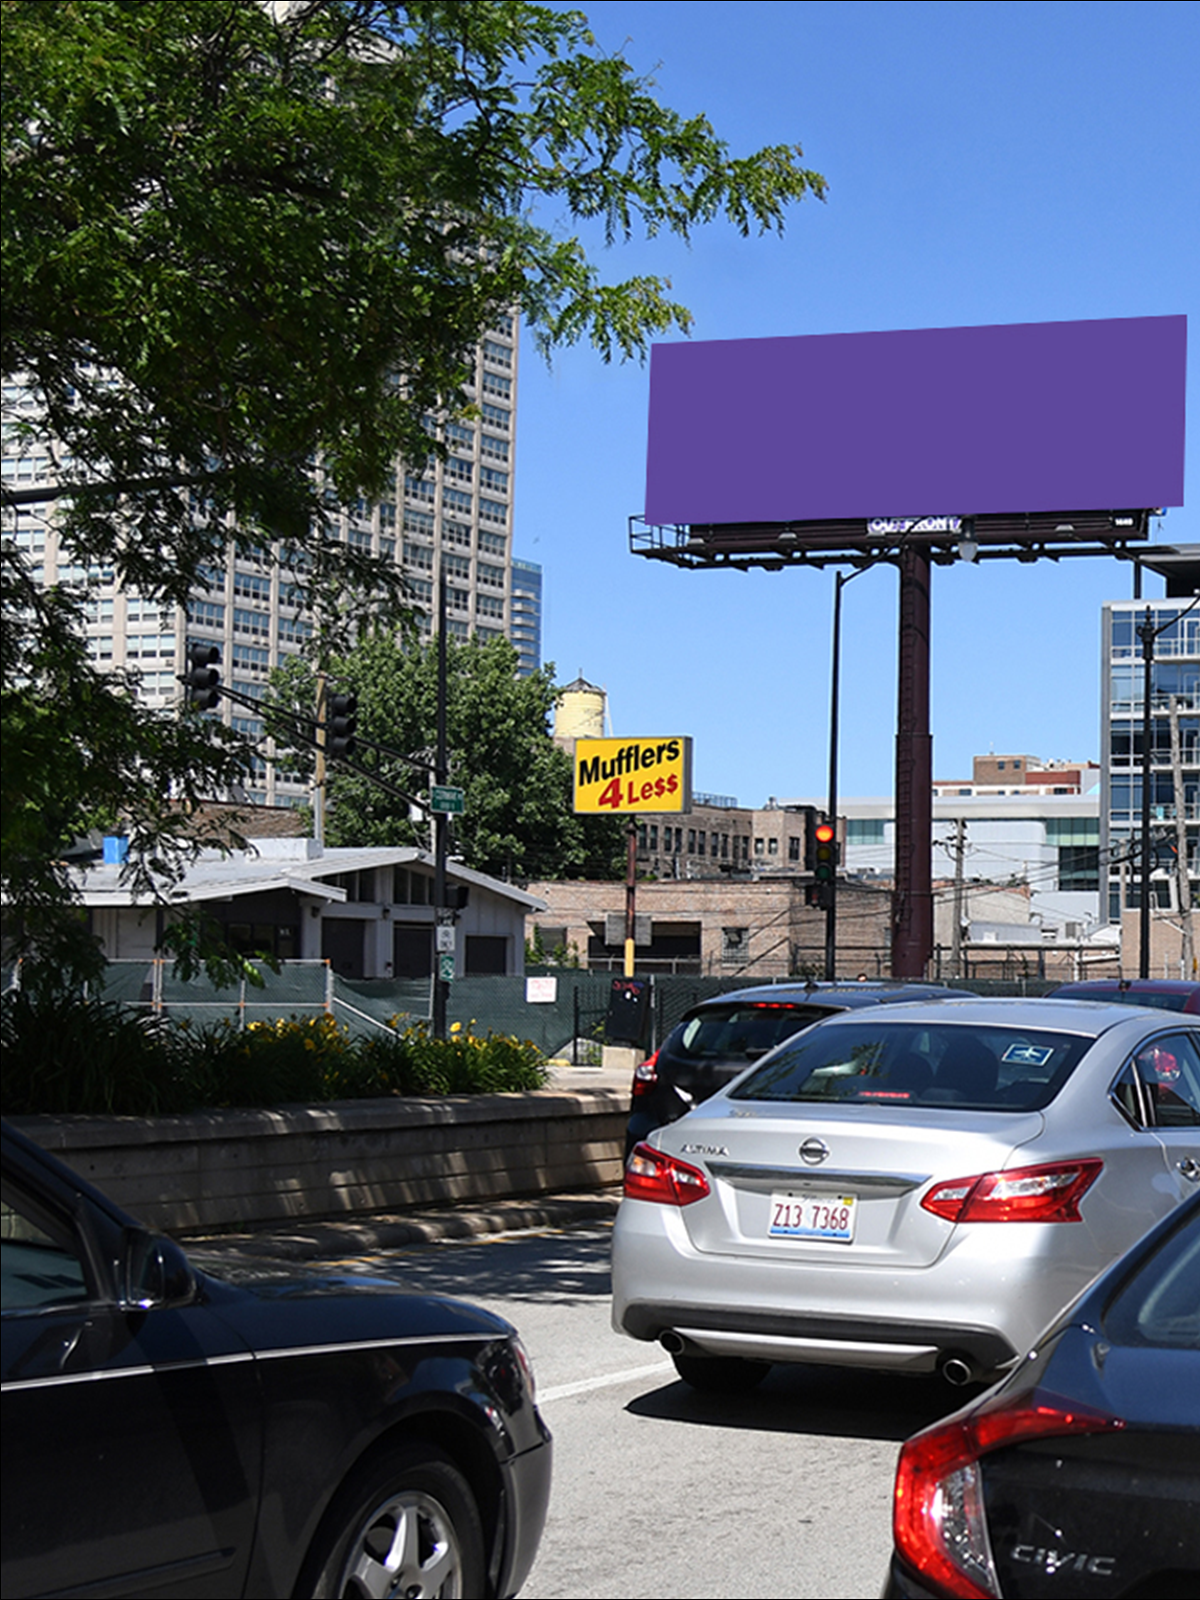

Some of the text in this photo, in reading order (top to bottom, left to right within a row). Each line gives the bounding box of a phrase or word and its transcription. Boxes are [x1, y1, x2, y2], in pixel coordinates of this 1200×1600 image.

[579, 740, 680, 787] Mufflers
[598, 778, 624, 809] 4
[680, 1143, 729, 1156] ALTIMA
[773, 1203, 849, 1231] Z13 7368
[1010, 1545, 1115, 1575] CIVIC
